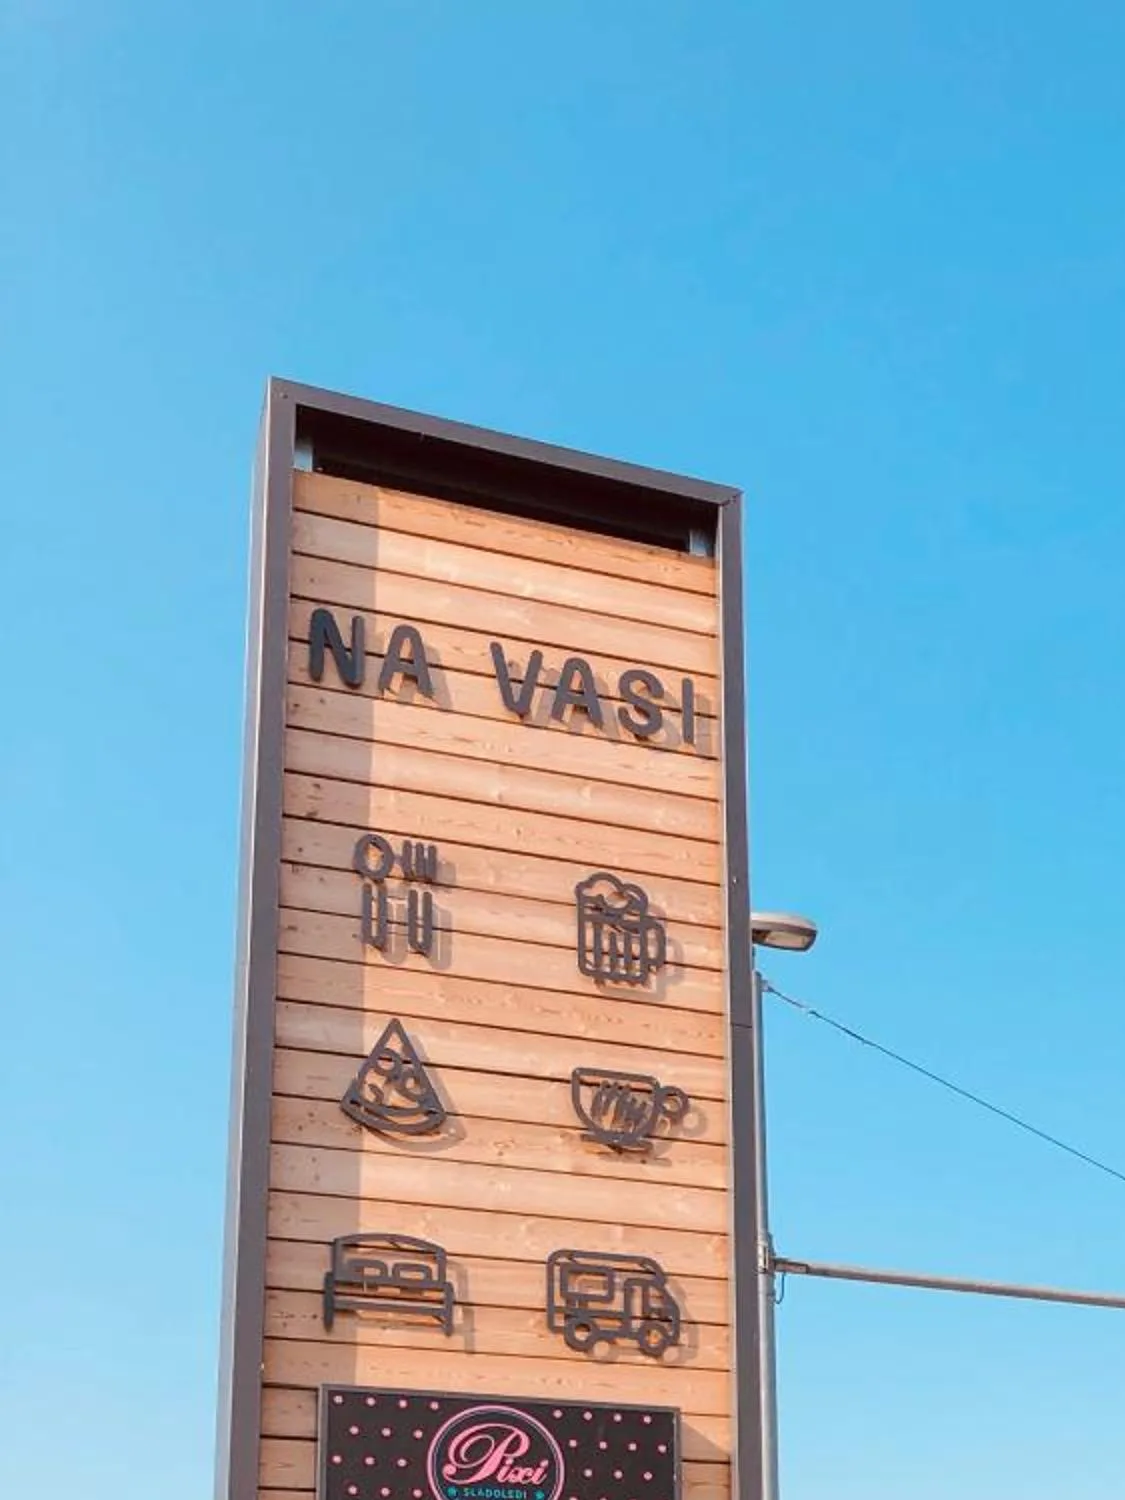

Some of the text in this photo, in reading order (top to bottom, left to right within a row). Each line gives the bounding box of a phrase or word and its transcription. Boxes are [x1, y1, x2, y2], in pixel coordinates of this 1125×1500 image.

[309, 608, 697, 746] NA VASI
[442, 1423, 549, 1485] Pixi
[463, 1487, 527, 1499] SLADOLEDI
